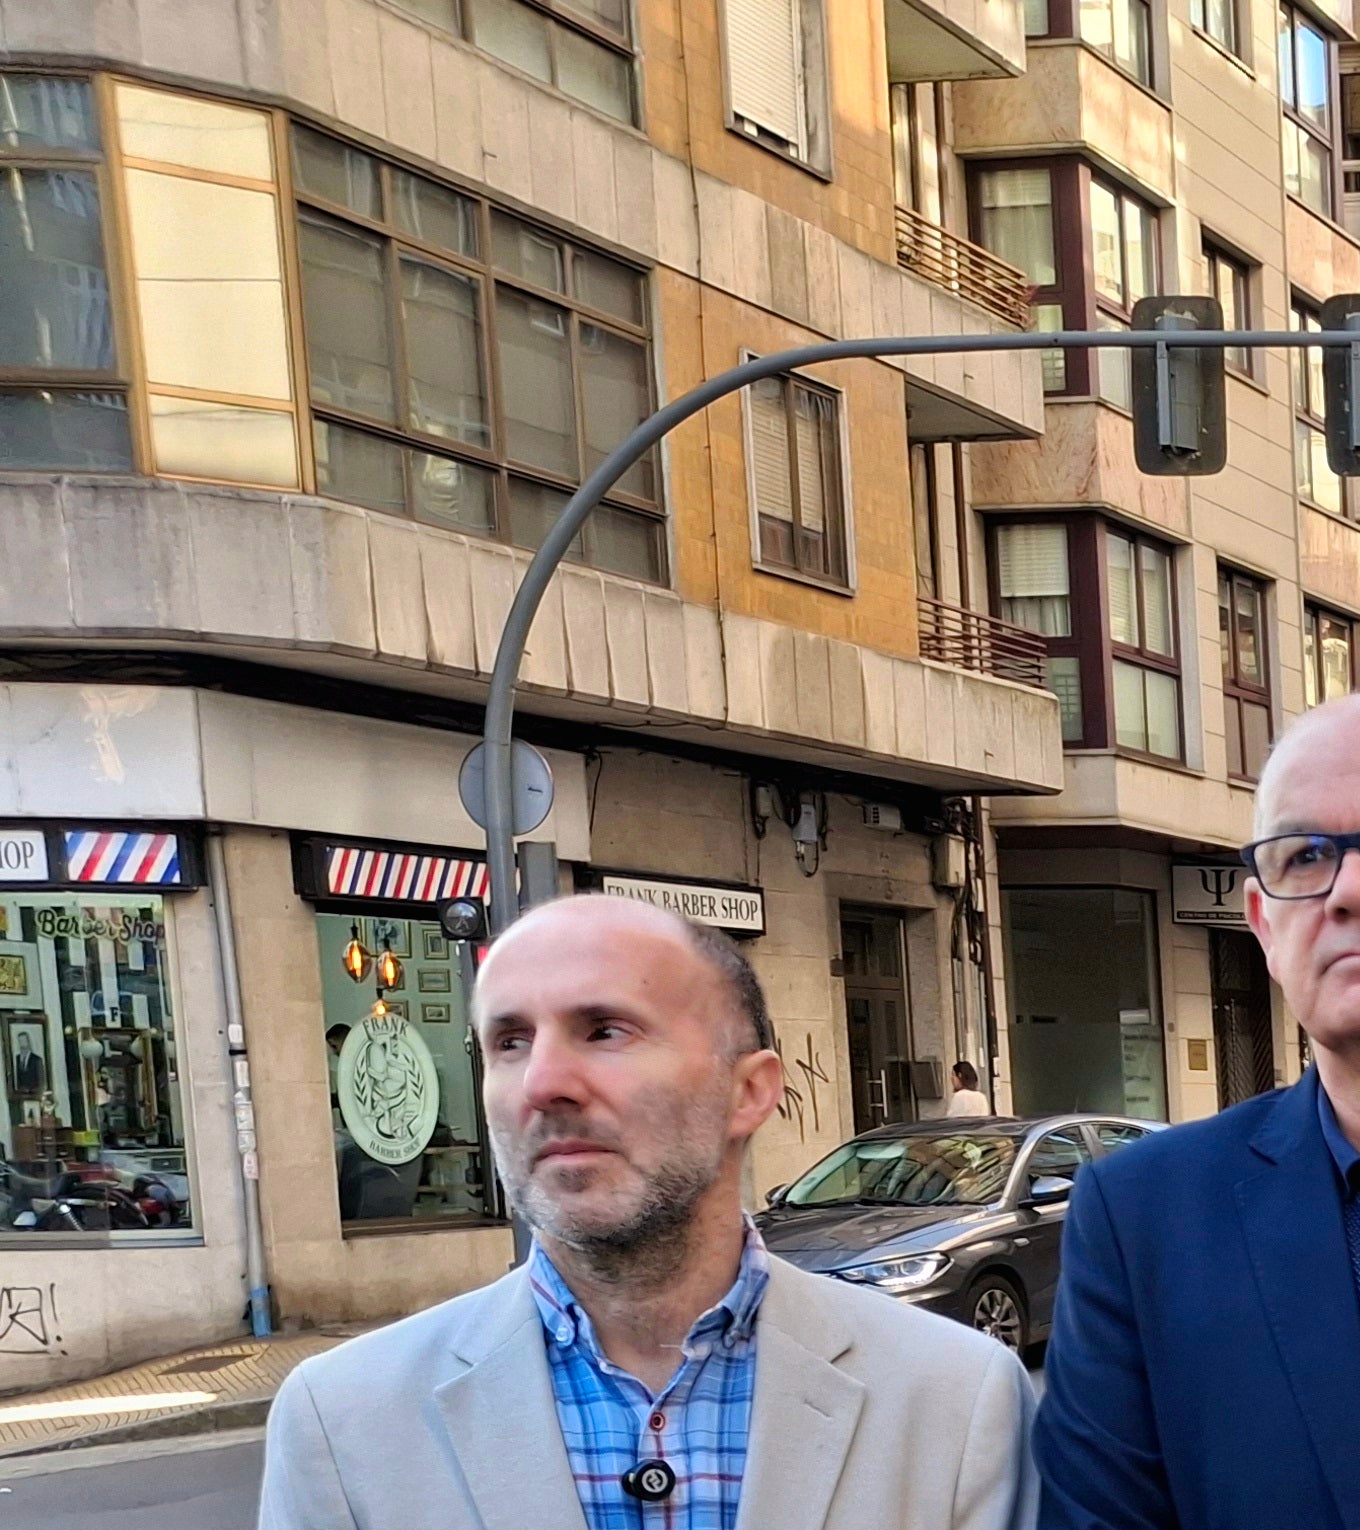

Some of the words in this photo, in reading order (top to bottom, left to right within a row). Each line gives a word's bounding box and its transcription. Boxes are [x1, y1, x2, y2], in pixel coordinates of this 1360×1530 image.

[662, 890, 718, 917] BARBER
[721, 896, 759, 921] SHOP
[38, 909, 116, 938] Barber
[120, 914, 165, 948] Shop
[362, 1016, 408, 1036] FRANK
